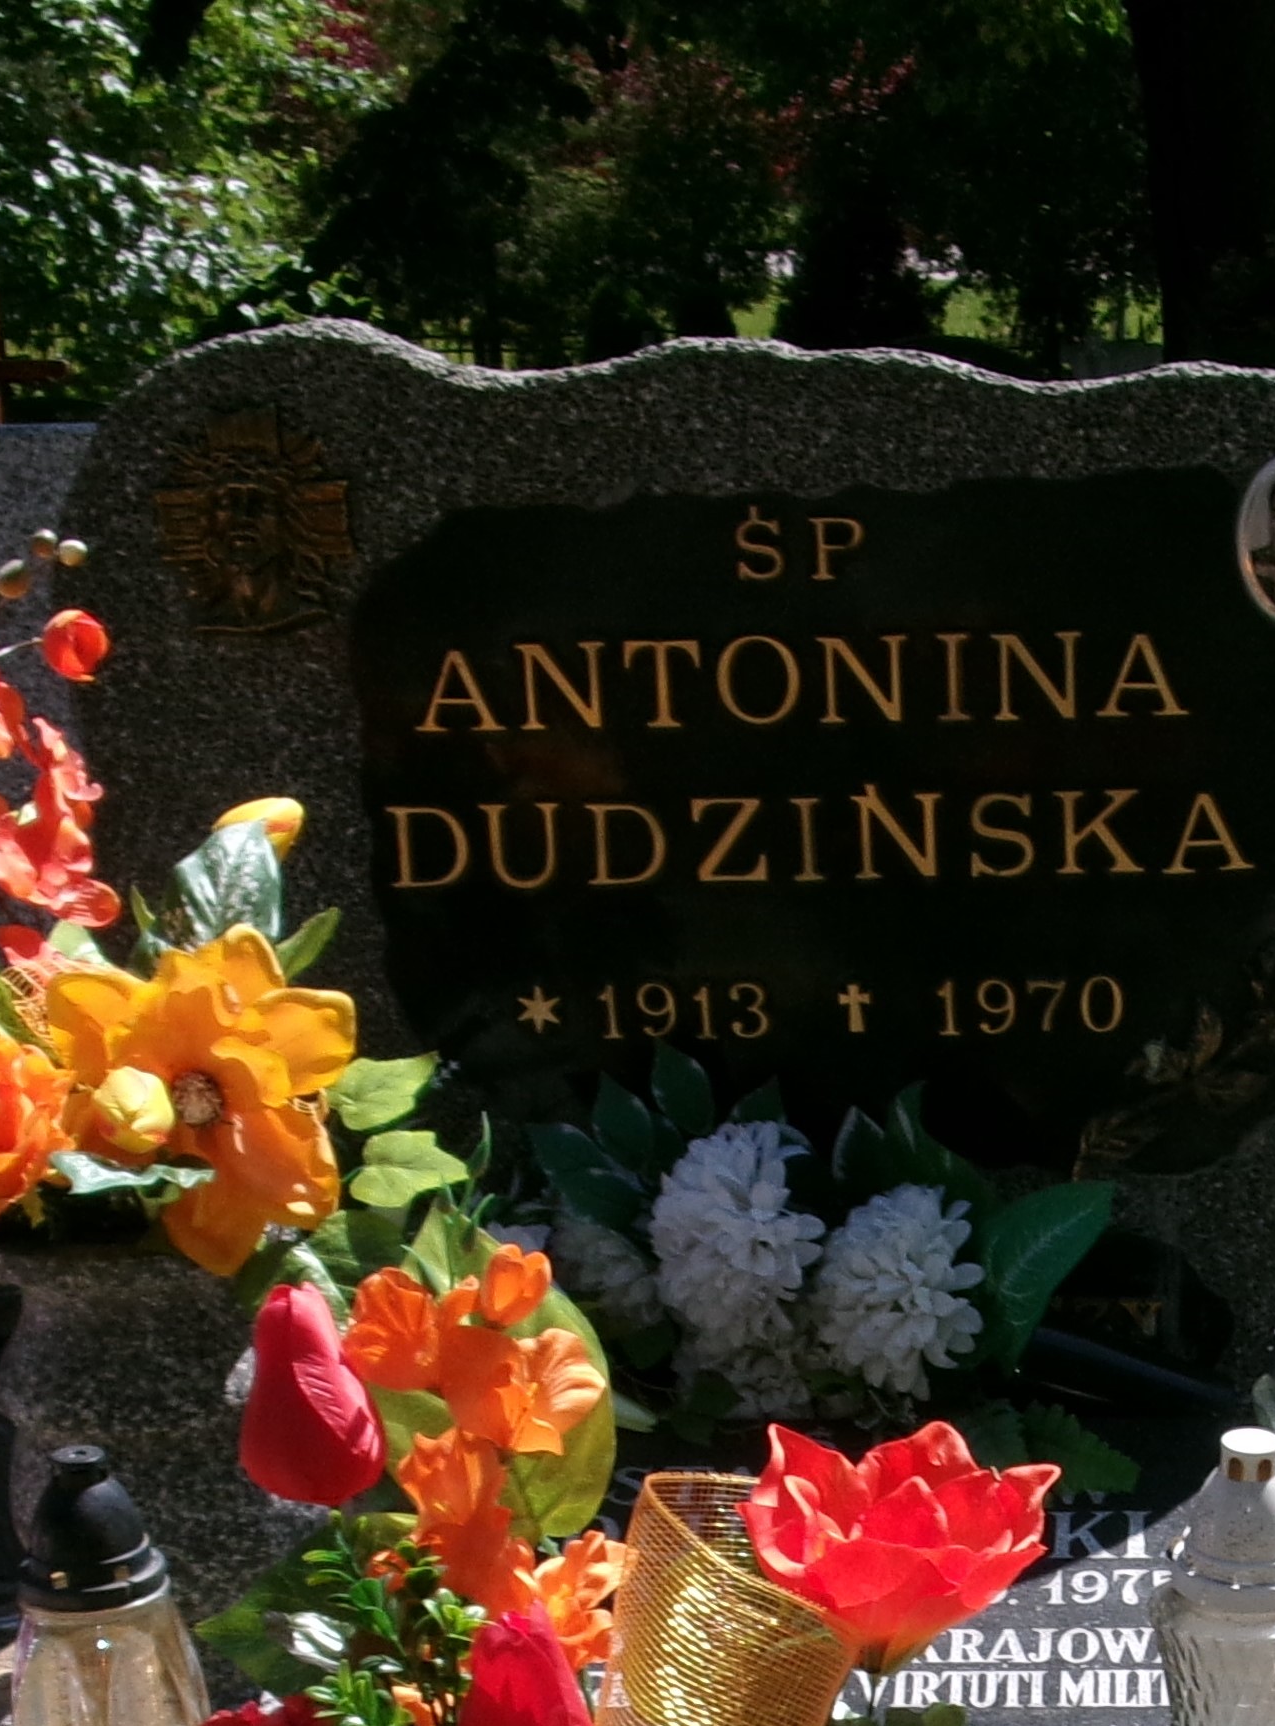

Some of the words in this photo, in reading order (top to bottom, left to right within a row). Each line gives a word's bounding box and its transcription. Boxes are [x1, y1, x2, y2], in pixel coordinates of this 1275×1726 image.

[415, 630, 1190, 733] ANTONINA
[386, 784, 1256, 890] DUDZIŃSKA
[599, 983, 772, 1040] 1913
[937, 976, 1126, 1038] 1970
[852, 1668, 1049, 1709] VIRTUTI
[1056, 1668, 1172, 1709] MILIT
